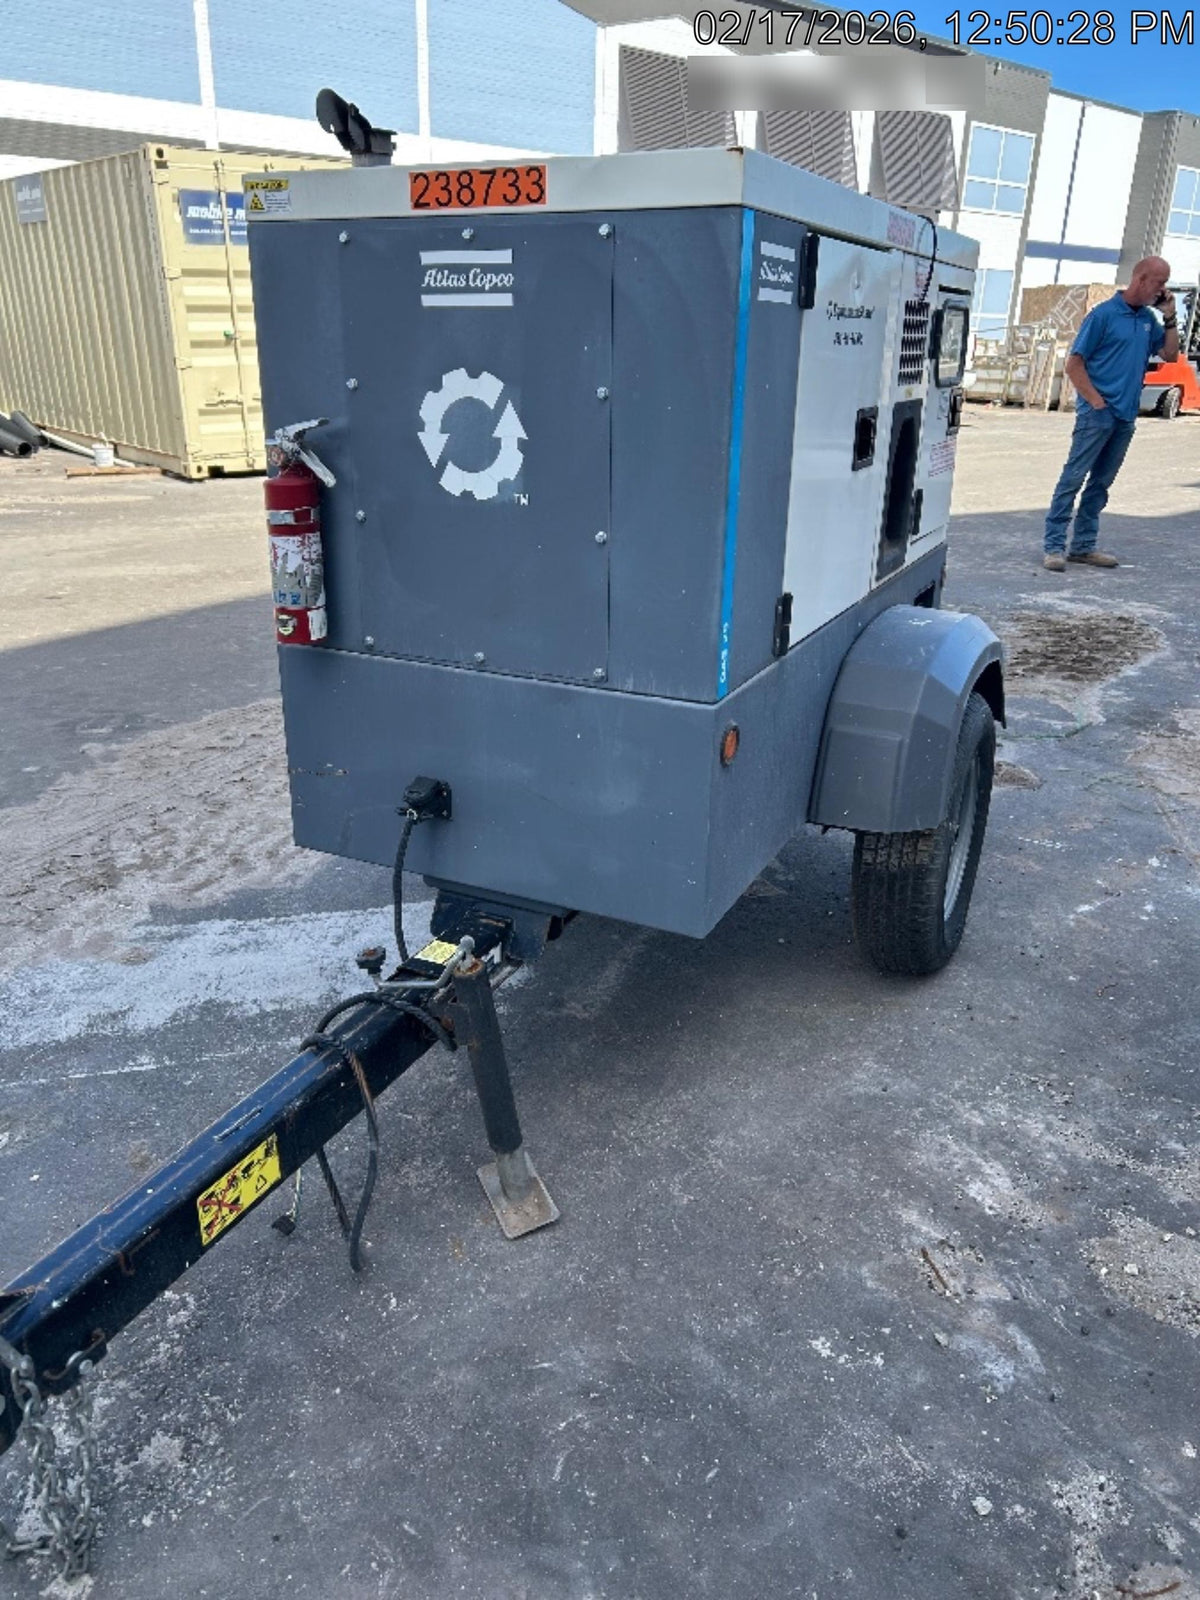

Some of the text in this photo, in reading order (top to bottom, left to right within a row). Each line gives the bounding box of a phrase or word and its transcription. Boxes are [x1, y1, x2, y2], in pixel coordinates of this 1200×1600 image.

[412, 165, 545, 208] 238733
[421, 267, 515, 291] Atlas Copco
